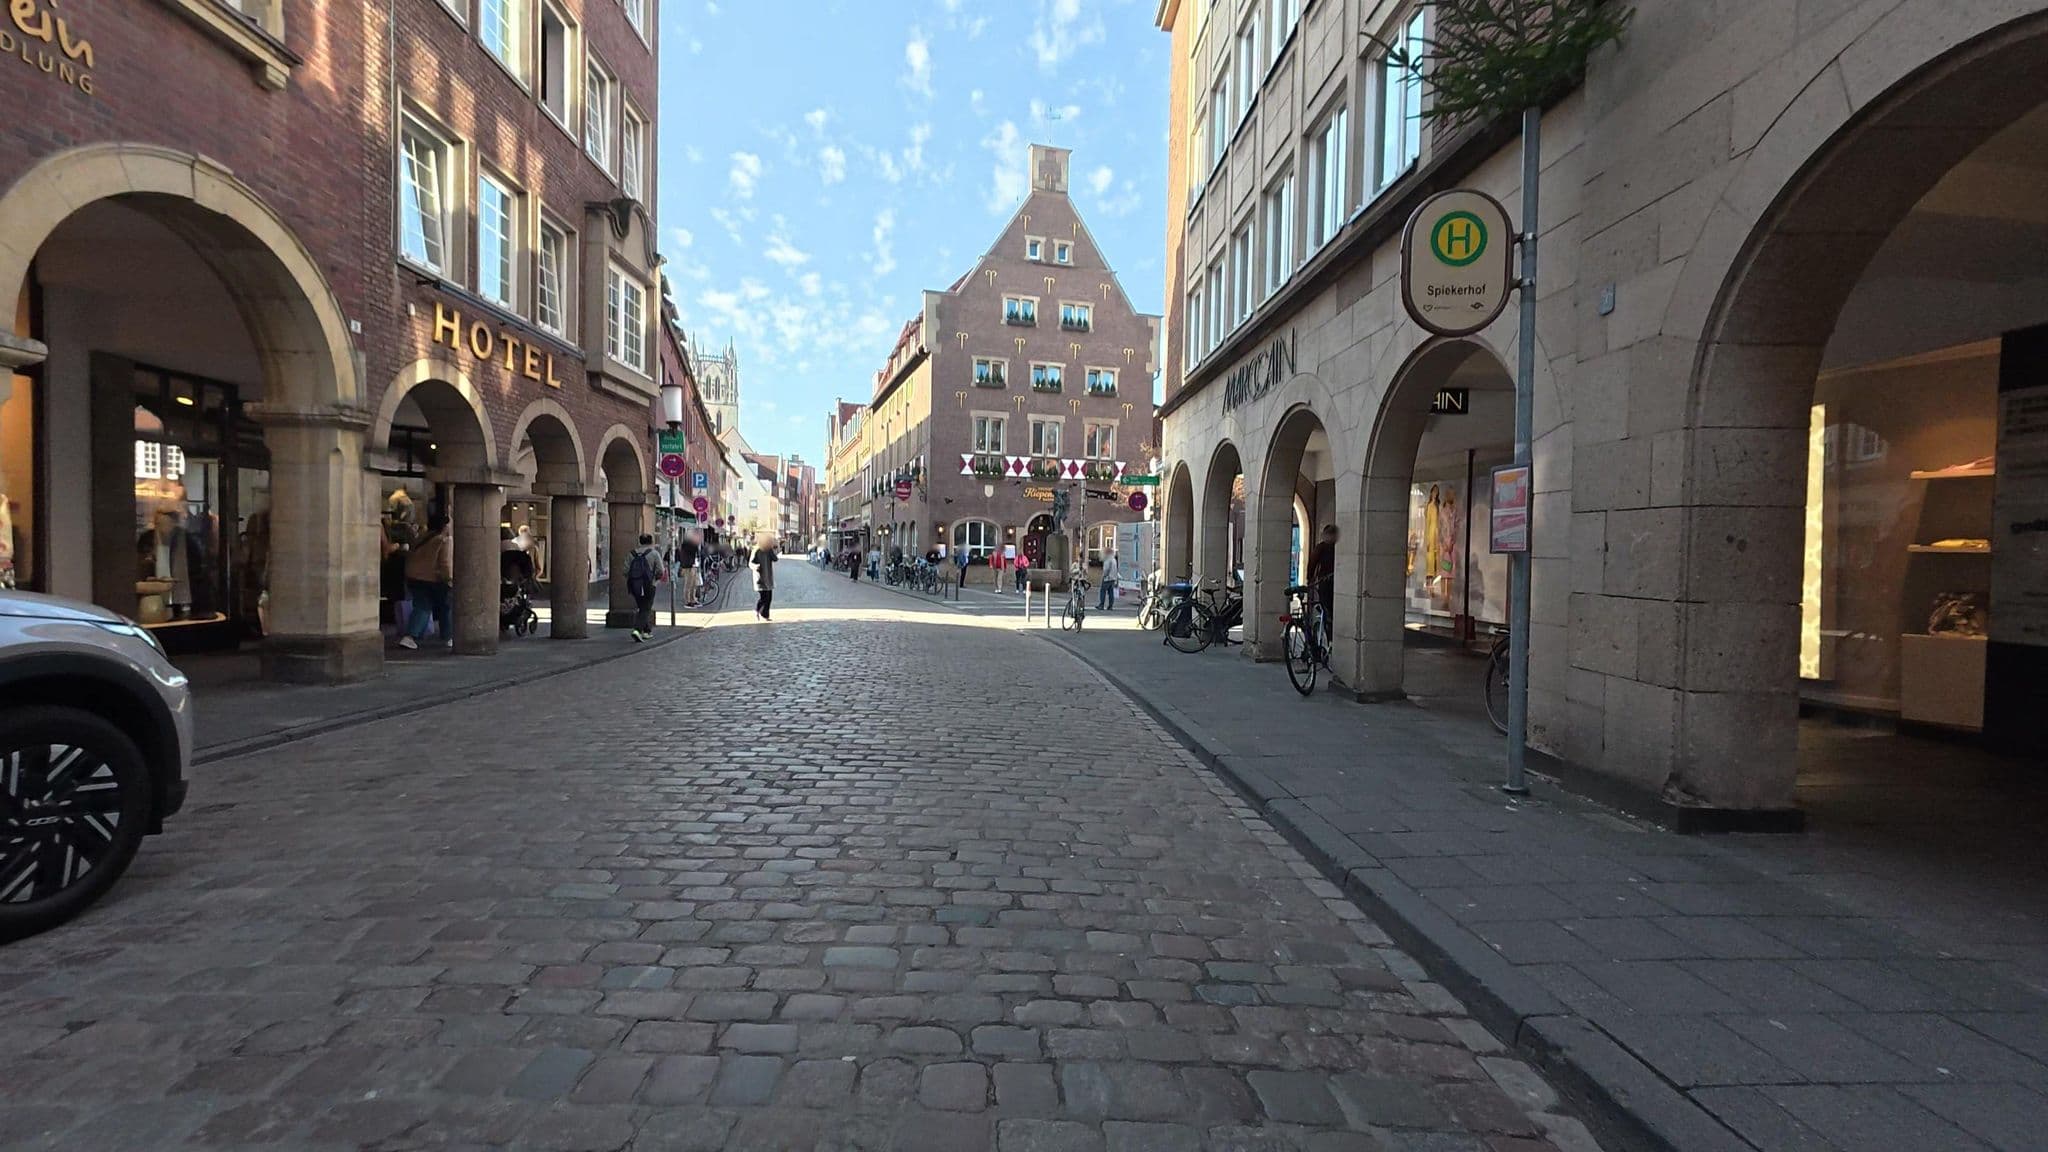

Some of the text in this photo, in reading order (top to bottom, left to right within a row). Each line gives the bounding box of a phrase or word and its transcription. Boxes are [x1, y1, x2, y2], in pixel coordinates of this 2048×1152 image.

[0, 29, 93, 95] DLUNG
[1447, 223, 1471, 255] H
[1427, 284, 1486, 298] Spiekerhof
[433, 301, 561, 389] HOTEL
